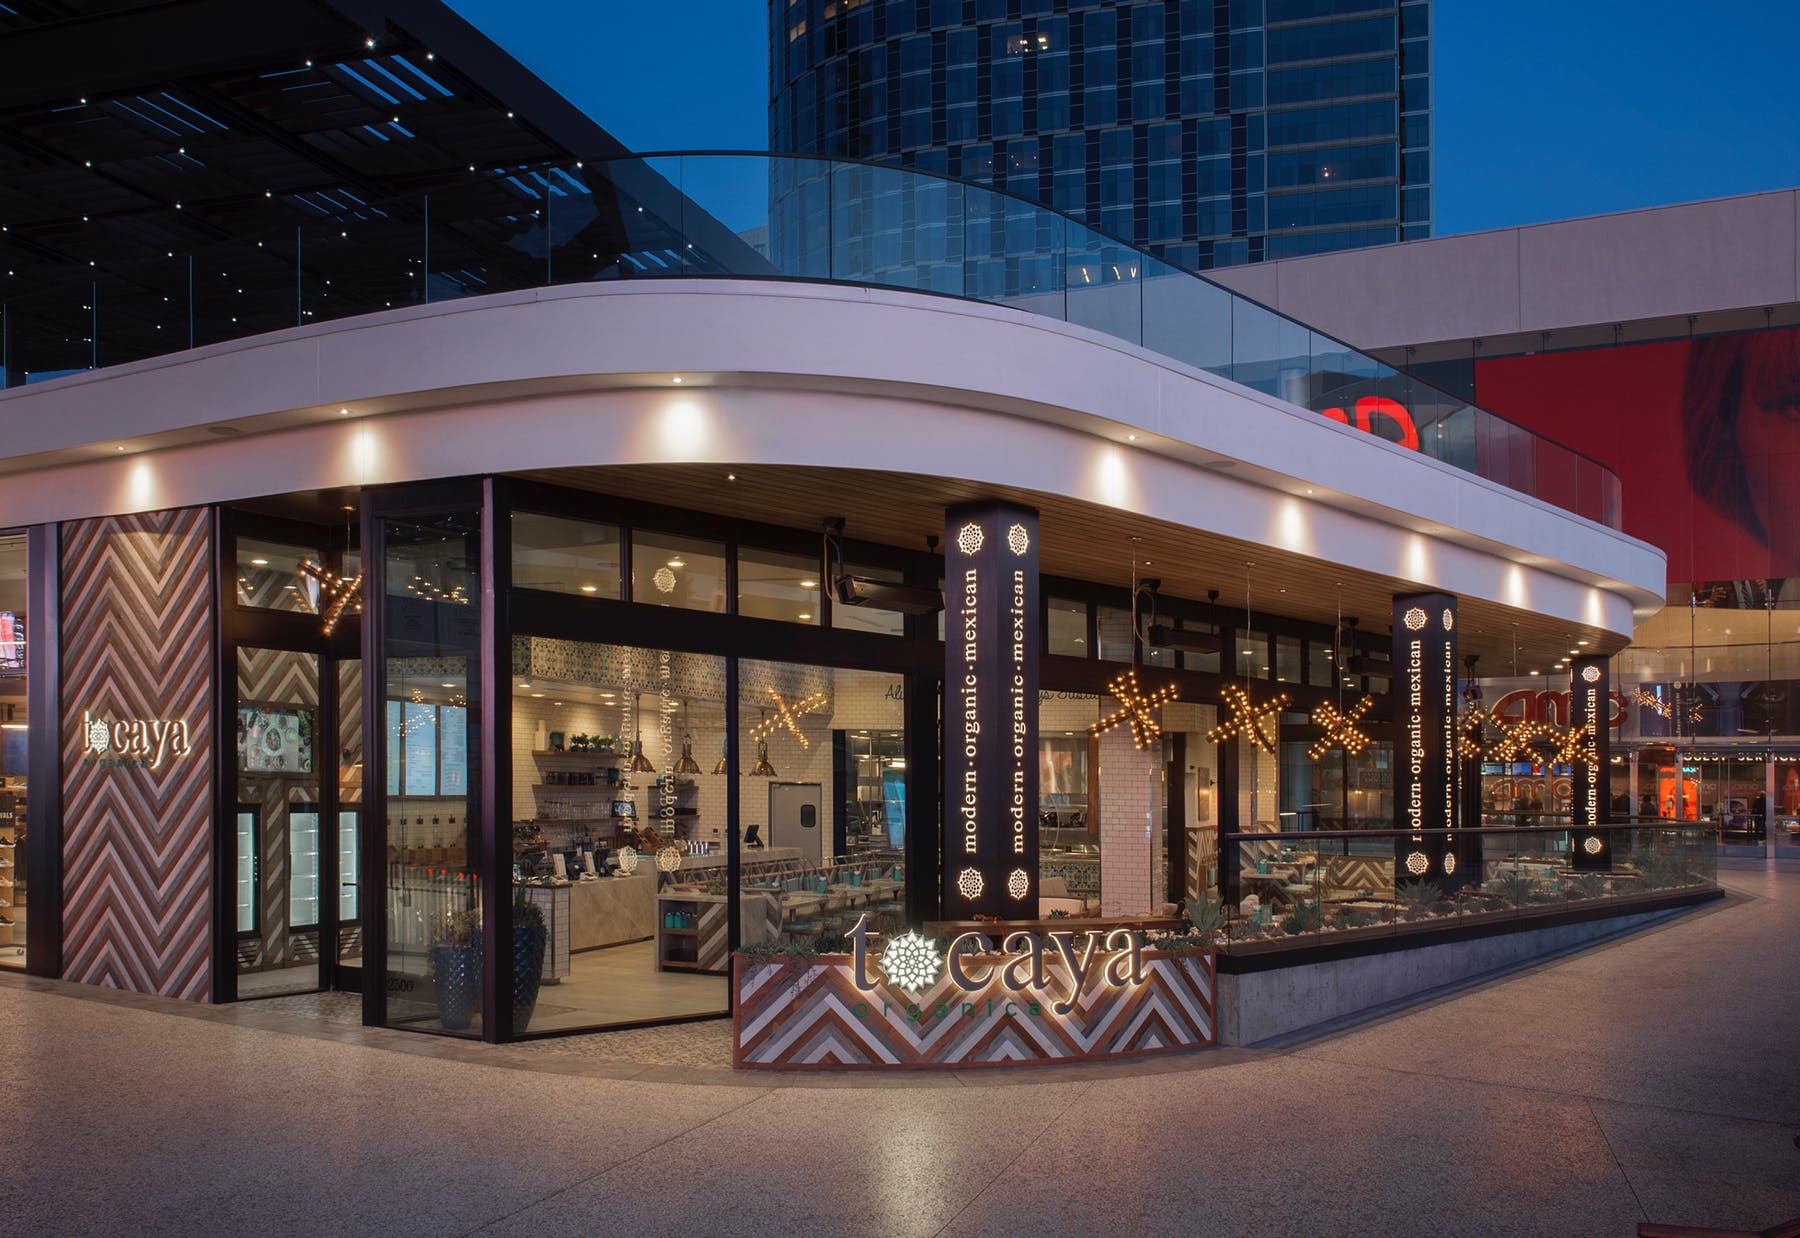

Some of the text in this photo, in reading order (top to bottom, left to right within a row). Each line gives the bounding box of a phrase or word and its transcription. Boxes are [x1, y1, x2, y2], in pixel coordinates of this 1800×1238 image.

[1407, 640, 1421, 706] mexican
[961, 569, 981, 854] modern organic mexican
[1010, 570, 1026, 854] modern organic mexican
[1407, 714, 1425, 774] organic
[1585, 740, 1599, 783] orgnic
[853, 999, 1042, 1022] organica
